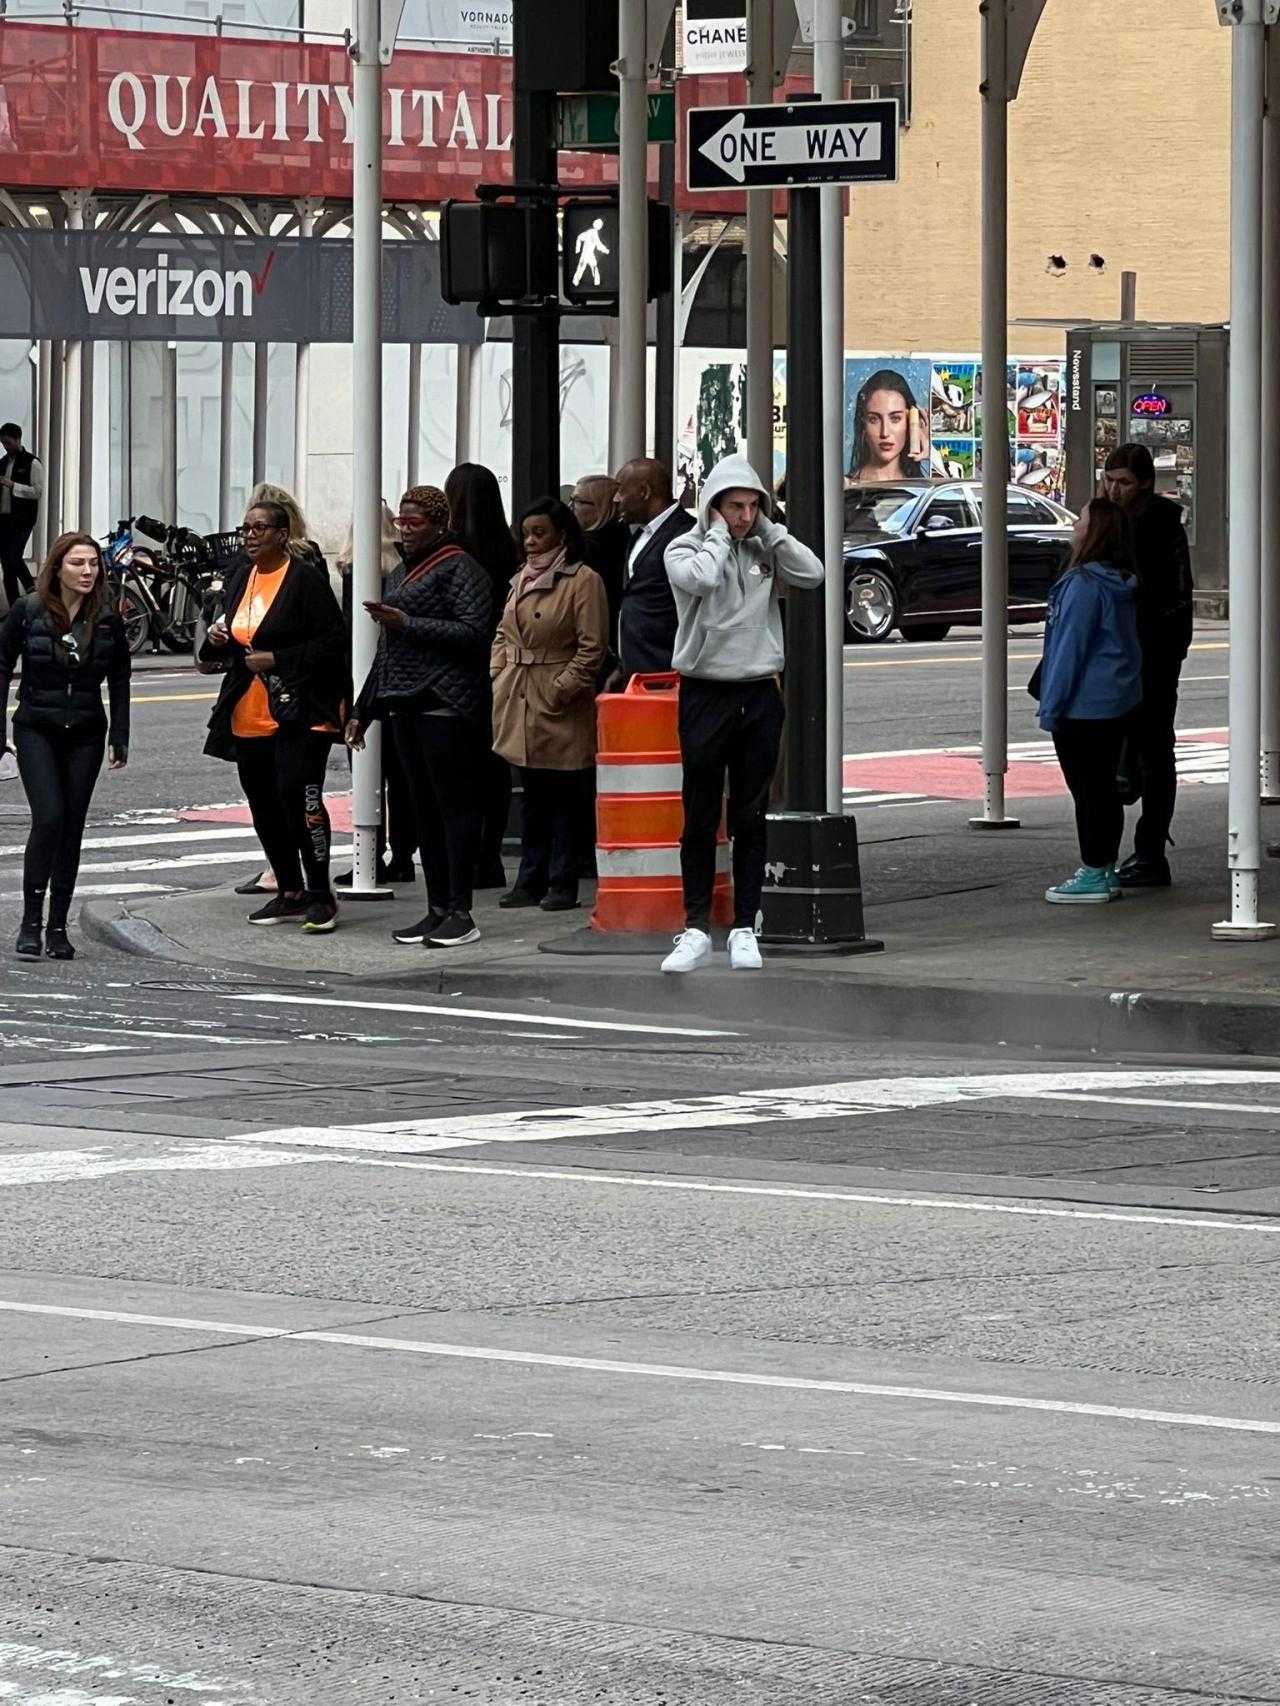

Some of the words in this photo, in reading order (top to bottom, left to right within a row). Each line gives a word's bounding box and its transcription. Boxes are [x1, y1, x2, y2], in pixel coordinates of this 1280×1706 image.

[687, 28, 747, 45] CHANE
[107, 71, 355, 150] QUALITY
[387, 88, 513, 151] ITAL
[720, 131, 776, 163] ONE
[806, 127, 868, 159] WAY
[79, 253, 252, 317] verizon
[1071, 349, 1082, 411] Newsstand
[1133, 399, 1166, 413] OPEN
[305, 784, 320, 812] LOUIS
